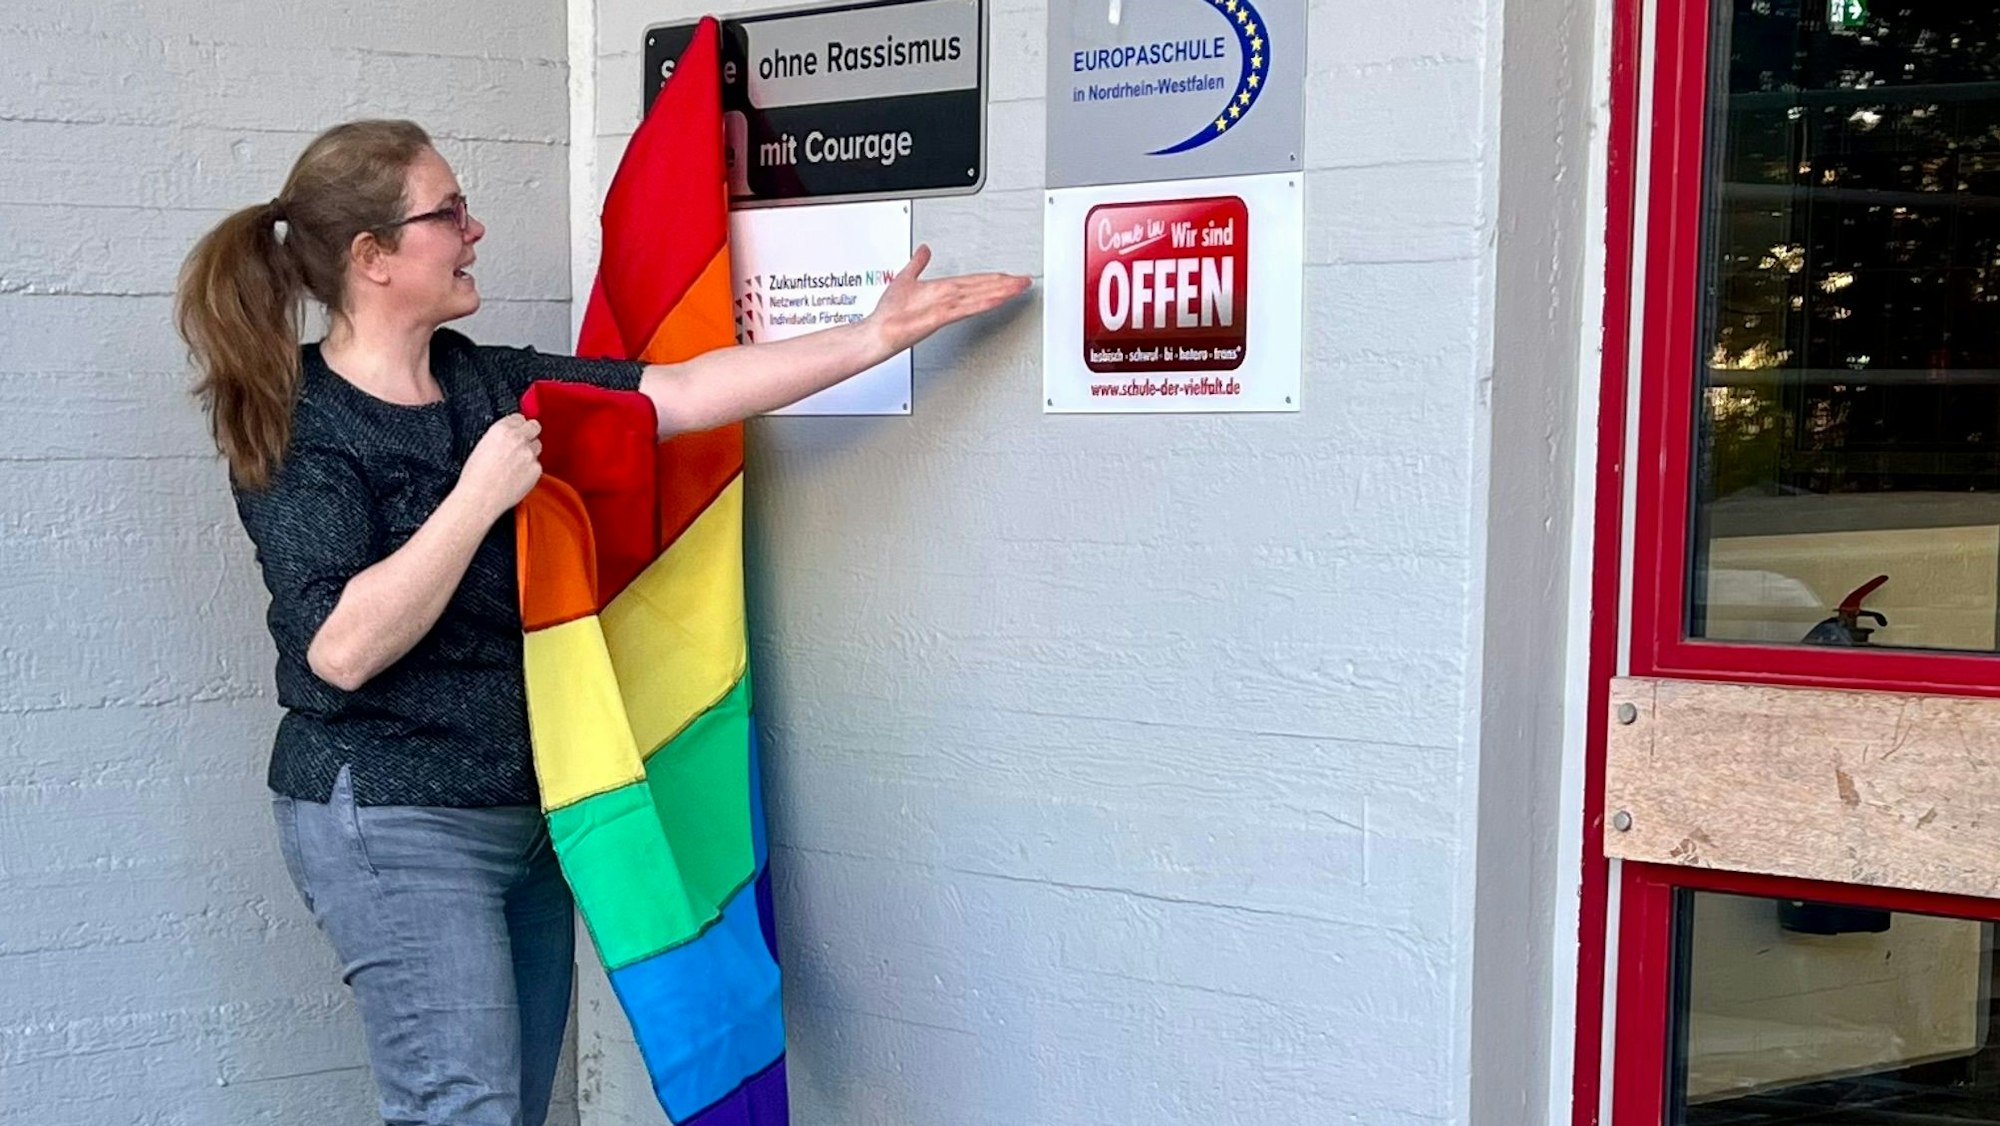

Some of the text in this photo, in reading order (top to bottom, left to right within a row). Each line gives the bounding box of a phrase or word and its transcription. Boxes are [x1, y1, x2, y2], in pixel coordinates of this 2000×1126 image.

[759, 49, 817, 80] ohne
[827, 35, 961, 73] Rassismus
[1073, 37, 1225, 72] EUROPASCHULE
[1073, 75, 1224, 102] in Nordrhein-Westfalen
[760, 133, 796, 167] mit
[805, 131, 913, 166] Courage
[1098, 218, 1166, 252] Come in
[1171, 218, 1234, 248] Wir sind
[769, 270, 894, 290] Zukunftsschulen NRW
[1098, 256, 1234, 331] OFFEN
[769, 295, 809, 308] Netzwerk
[1163, 346, 1174, 361] bi
[1091, 376, 1241, 396] www.schule-der-vielfalt.de
